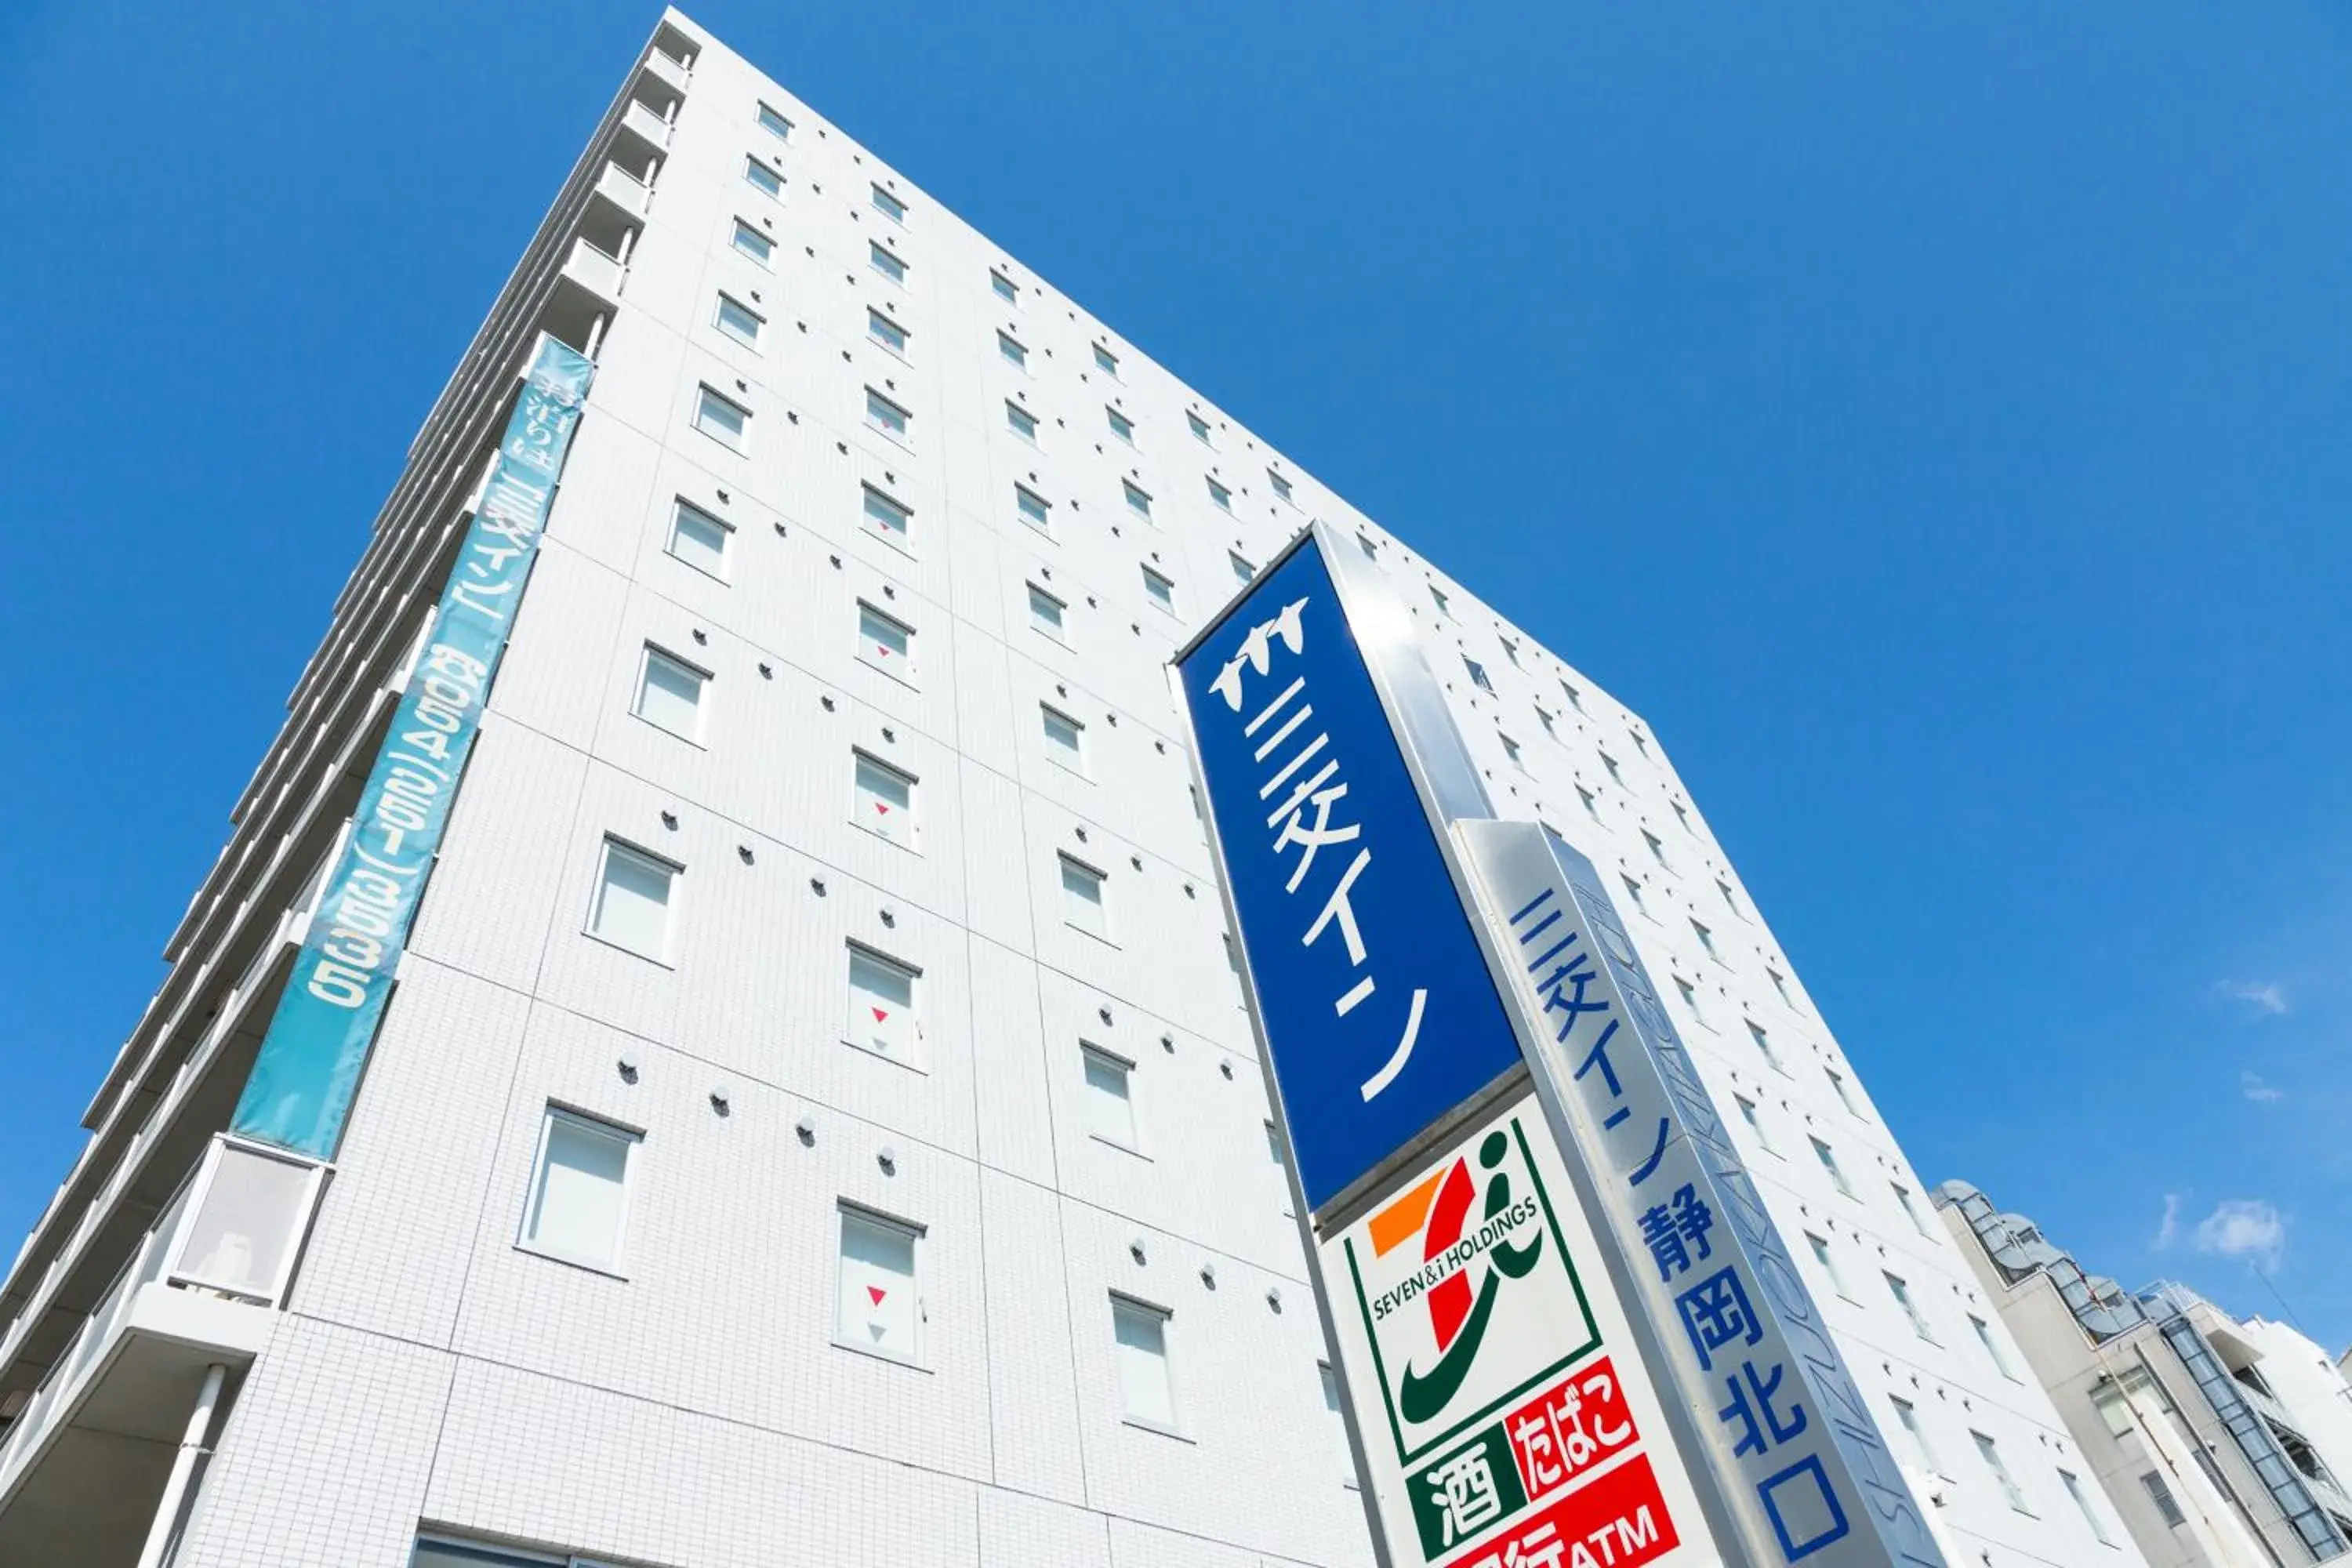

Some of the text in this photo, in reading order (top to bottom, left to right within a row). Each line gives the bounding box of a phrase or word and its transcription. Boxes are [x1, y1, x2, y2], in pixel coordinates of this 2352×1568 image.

[1243, 676, 1428, 1103] 三交イン
[1446, 1196, 1537, 1271] HOLDINGS
[1515, 1373, 1632, 1494] たばこ
[1425, 1442, 1502, 1547] 酒
